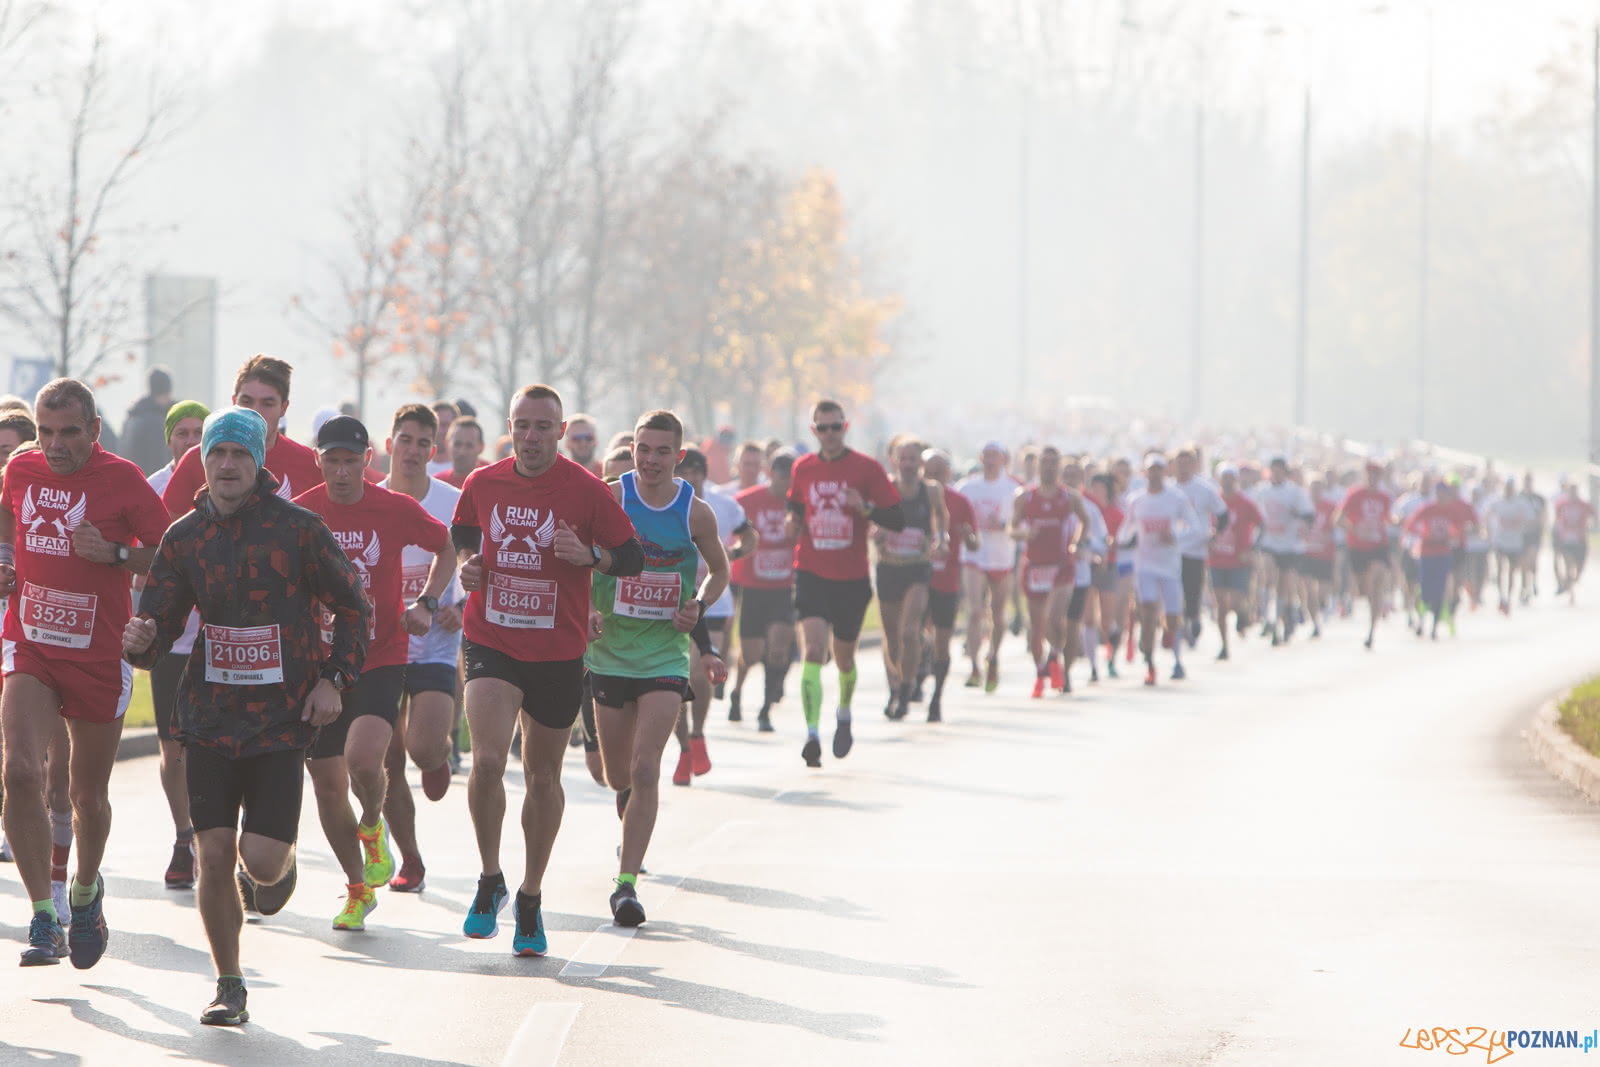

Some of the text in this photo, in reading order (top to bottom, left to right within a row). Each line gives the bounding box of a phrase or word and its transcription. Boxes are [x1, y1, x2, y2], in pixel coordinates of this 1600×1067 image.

[39, 487, 71, 505] RUN
[36, 499, 69, 511] POLAND
[506, 506, 539, 521] RUN
[505, 518, 538, 528] POLAND
[28, 535, 69, 550] TEAM
[500, 551, 540, 565] TEAM
[499, 591, 541, 610] 8840
[625, 584, 673, 601] 12047
[31, 603, 77, 627] 3523
[214, 644, 271, 663] 21096
[272, 652, 279, 660] B
